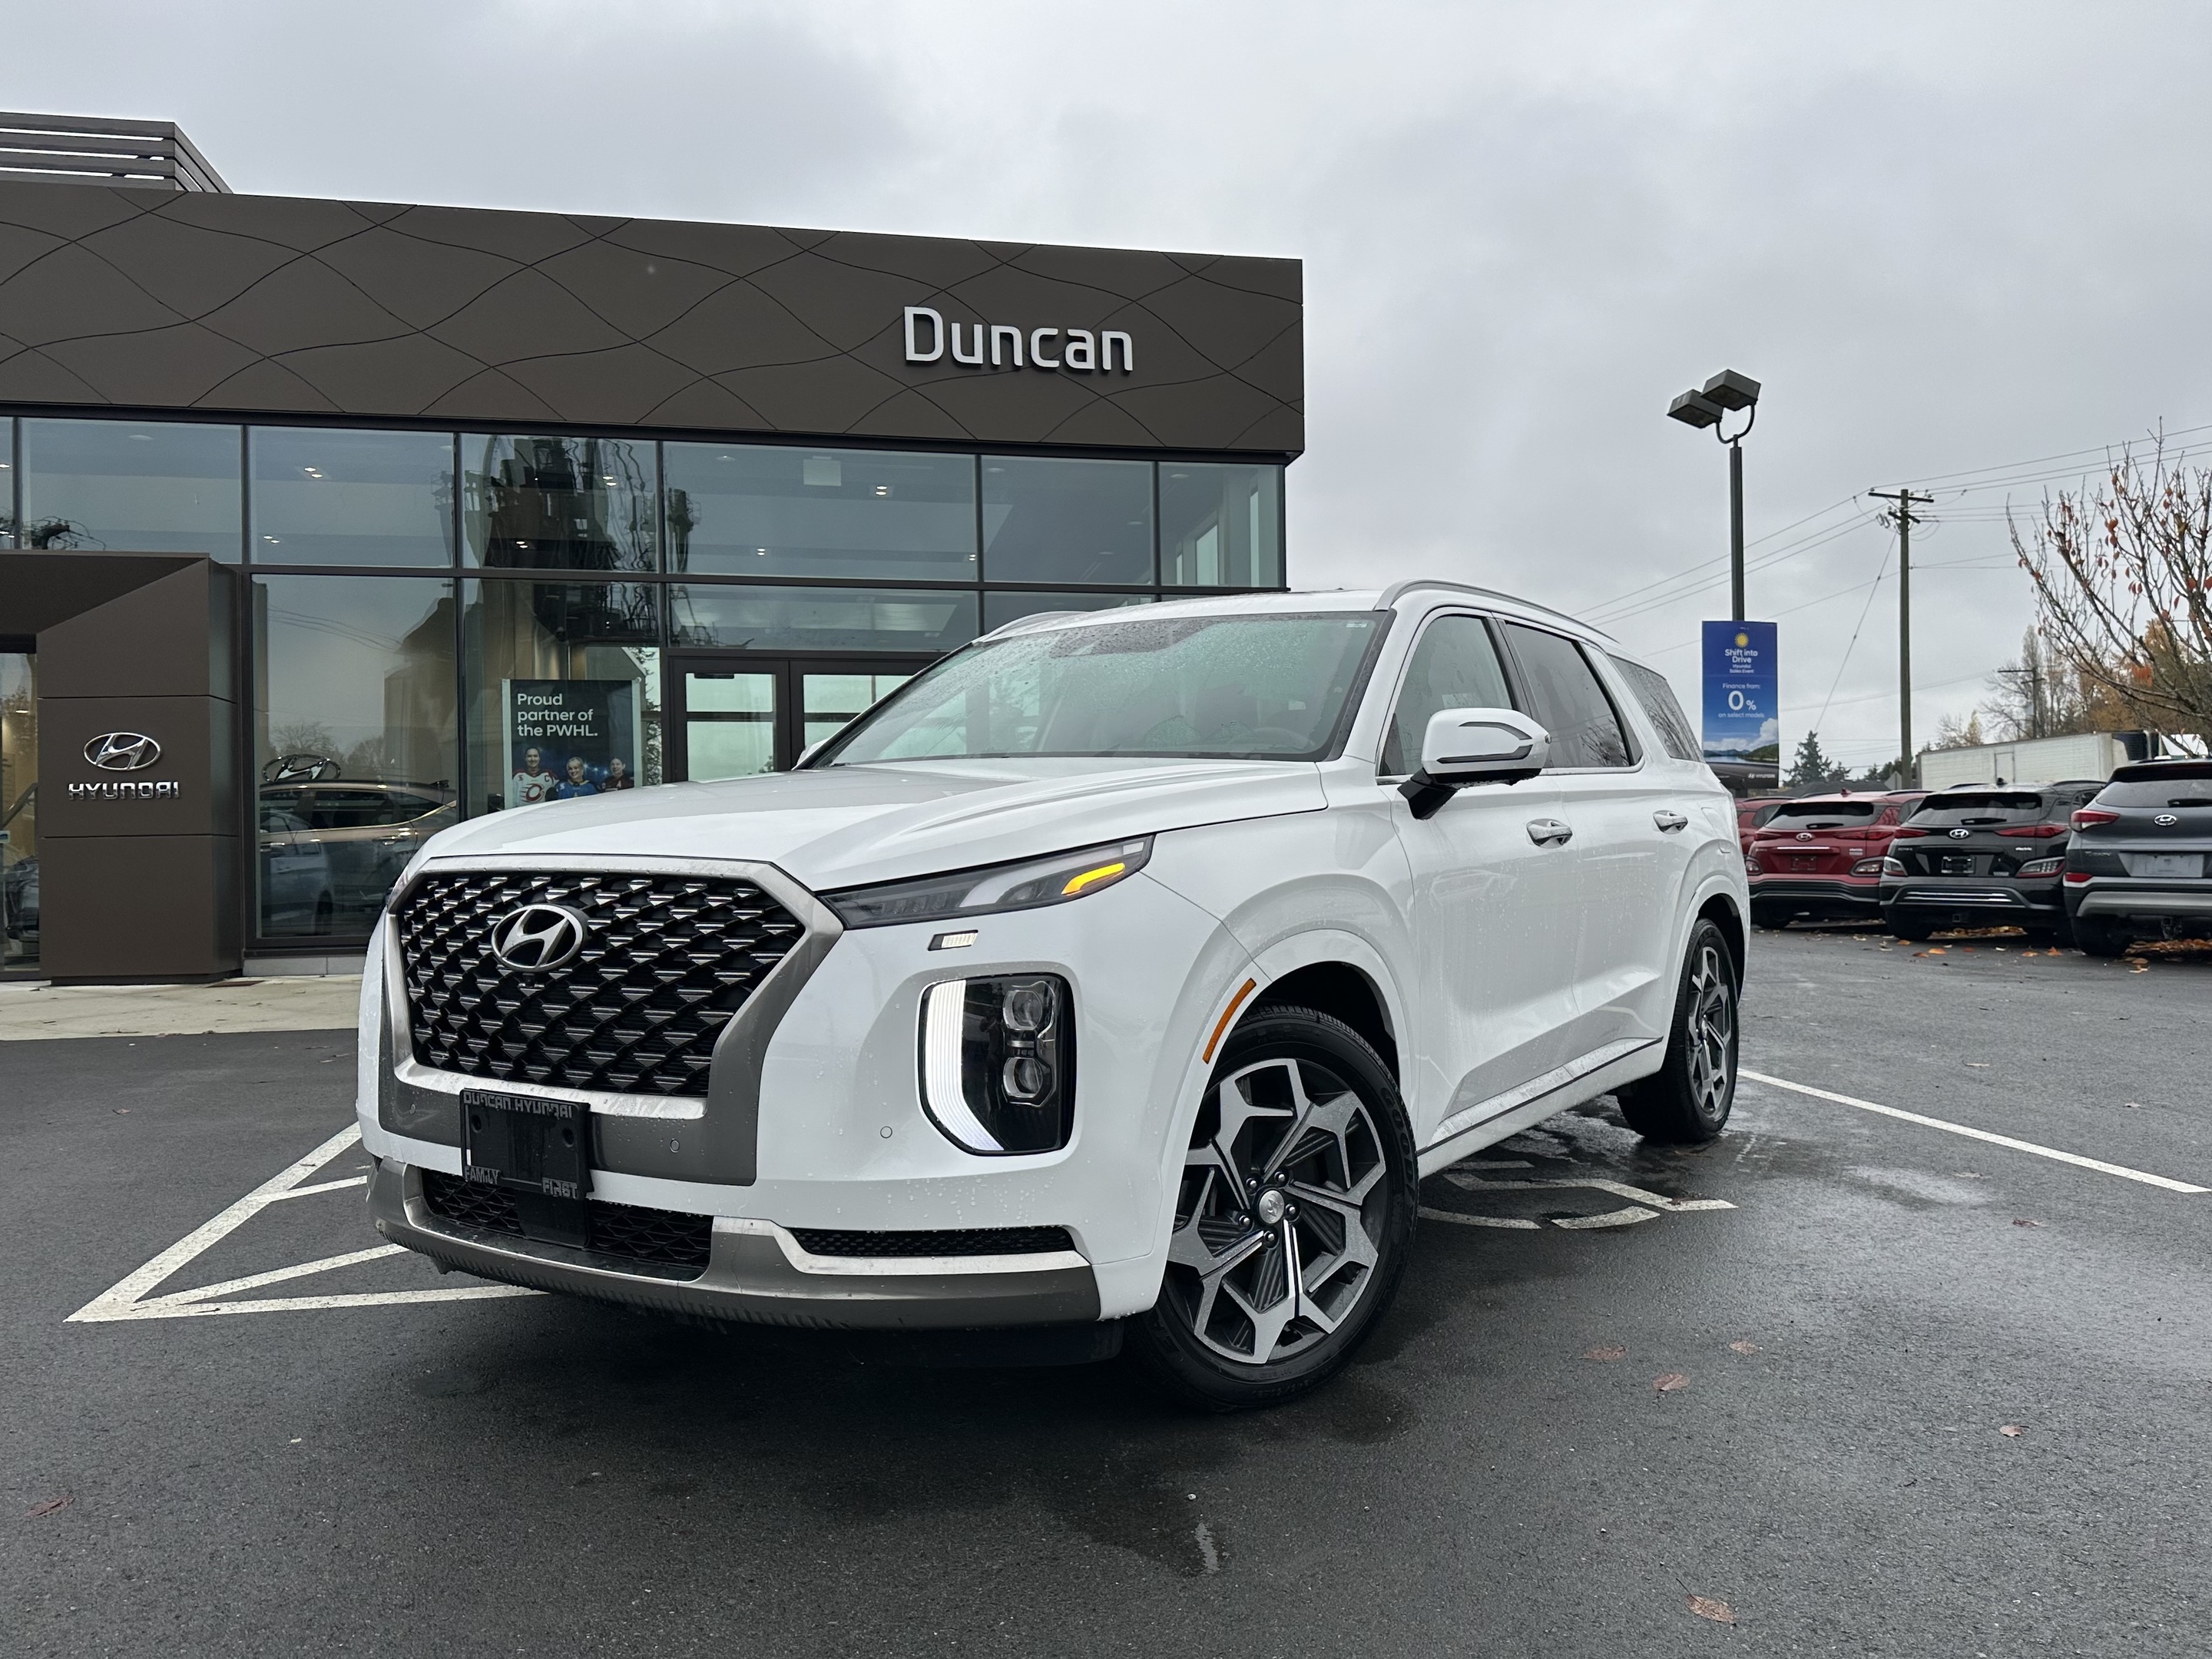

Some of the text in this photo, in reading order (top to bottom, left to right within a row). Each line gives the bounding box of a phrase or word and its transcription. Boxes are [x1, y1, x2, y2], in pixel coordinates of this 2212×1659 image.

[904, 306, 1134, 371] Duncan
[517, 693, 563, 706] Proud
[517, 709, 594, 724] partner of
[517, 724, 598, 737] the PWHL.
[68, 781, 180, 800] HYUNDAI
[463, 1091, 572, 1118] DUNCAN HYUNDAI
[464, 1166, 499, 1184] FAMILY
